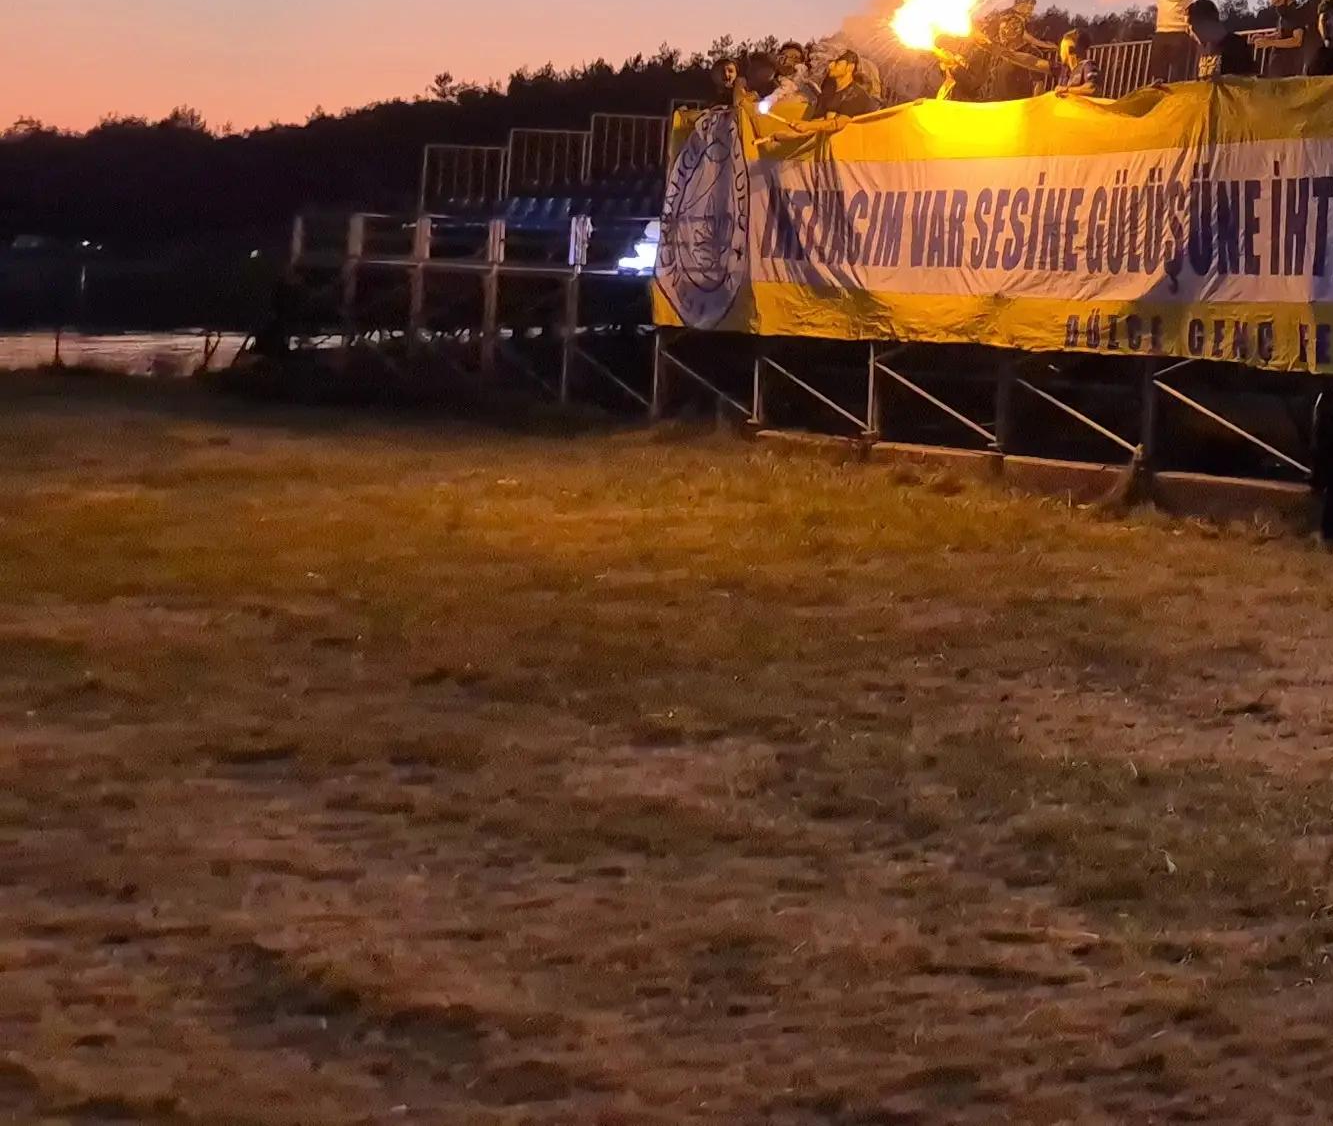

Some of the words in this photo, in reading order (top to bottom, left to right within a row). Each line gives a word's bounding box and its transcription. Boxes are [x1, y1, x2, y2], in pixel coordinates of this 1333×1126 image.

[910, 189, 968, 269] VAR
[970, 171, 1085, 272] SESİNE
[1086, 162, 1261, 294] GÜLÜŞÜNE
[1187, 318, 1274, 365] GENÇ
